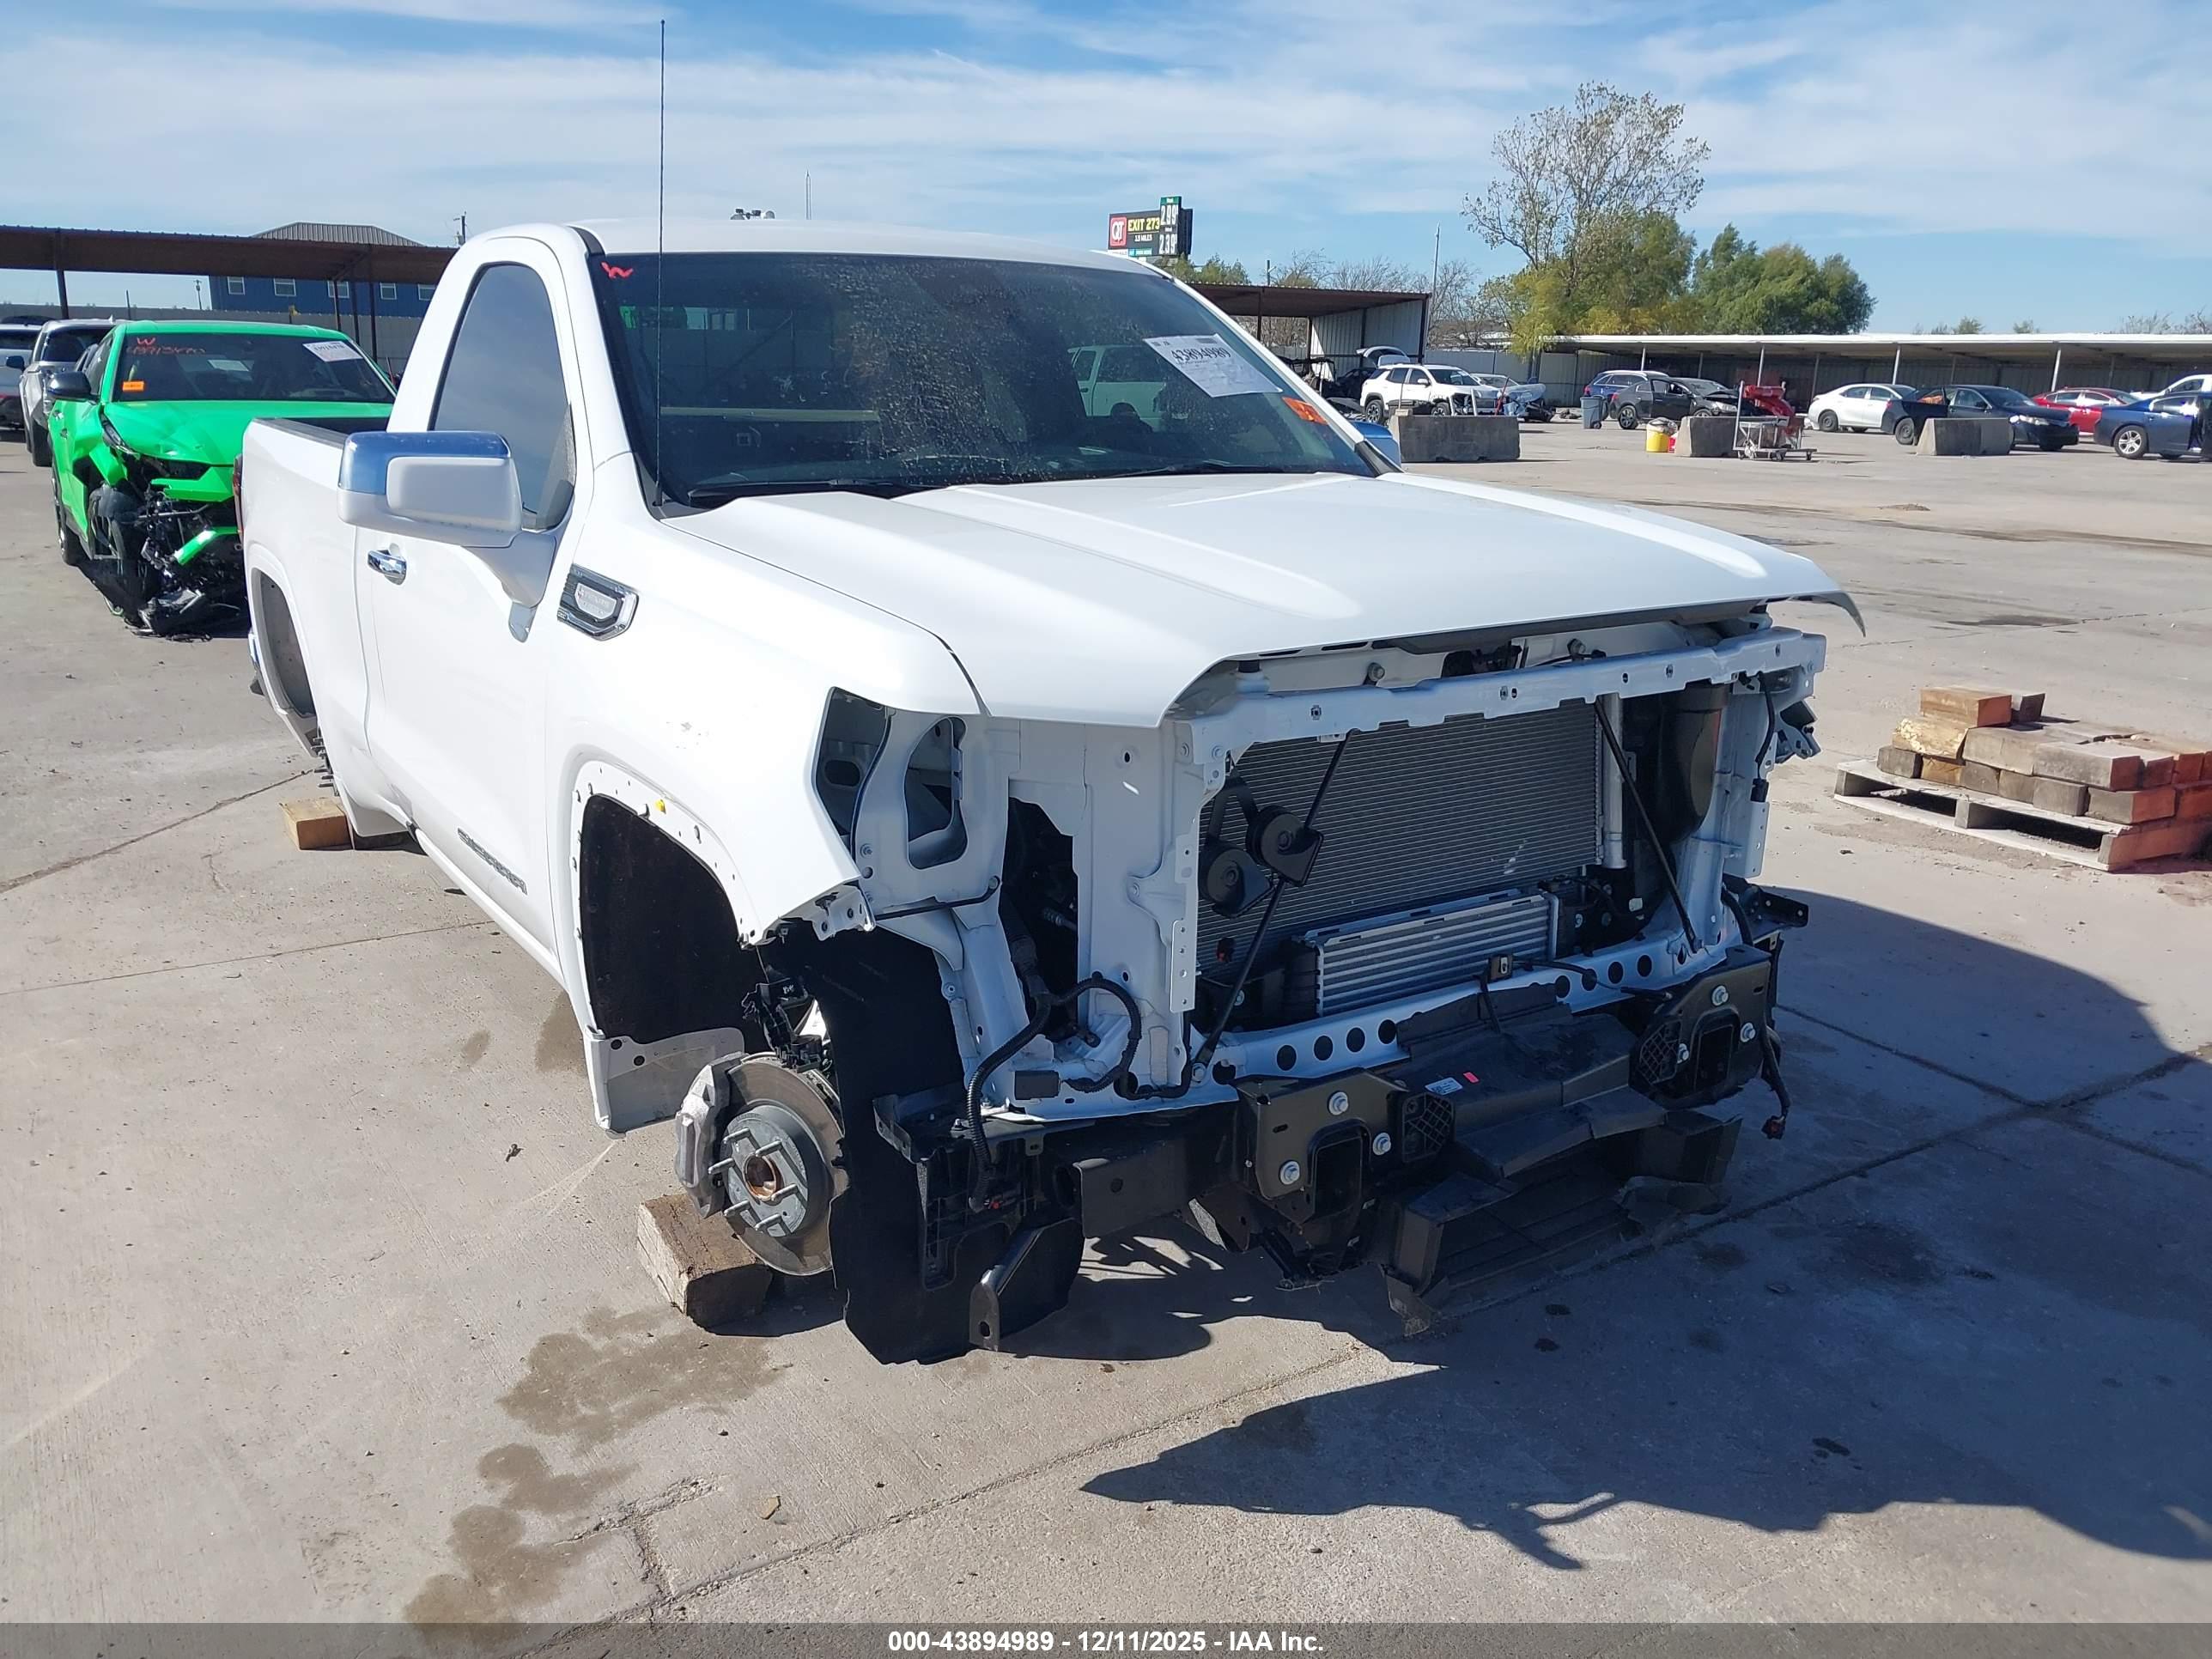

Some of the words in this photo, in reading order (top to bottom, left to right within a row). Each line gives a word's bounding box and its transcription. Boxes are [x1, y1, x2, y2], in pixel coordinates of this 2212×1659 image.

[1127, 218, 1146, 232] EXIT
[1146, 216, 1160, 230] 273
[1112, 221, 1125, 243] QT
[137, 337, 156, 346] W
[1170, 347, 1231, 362] 43894989
